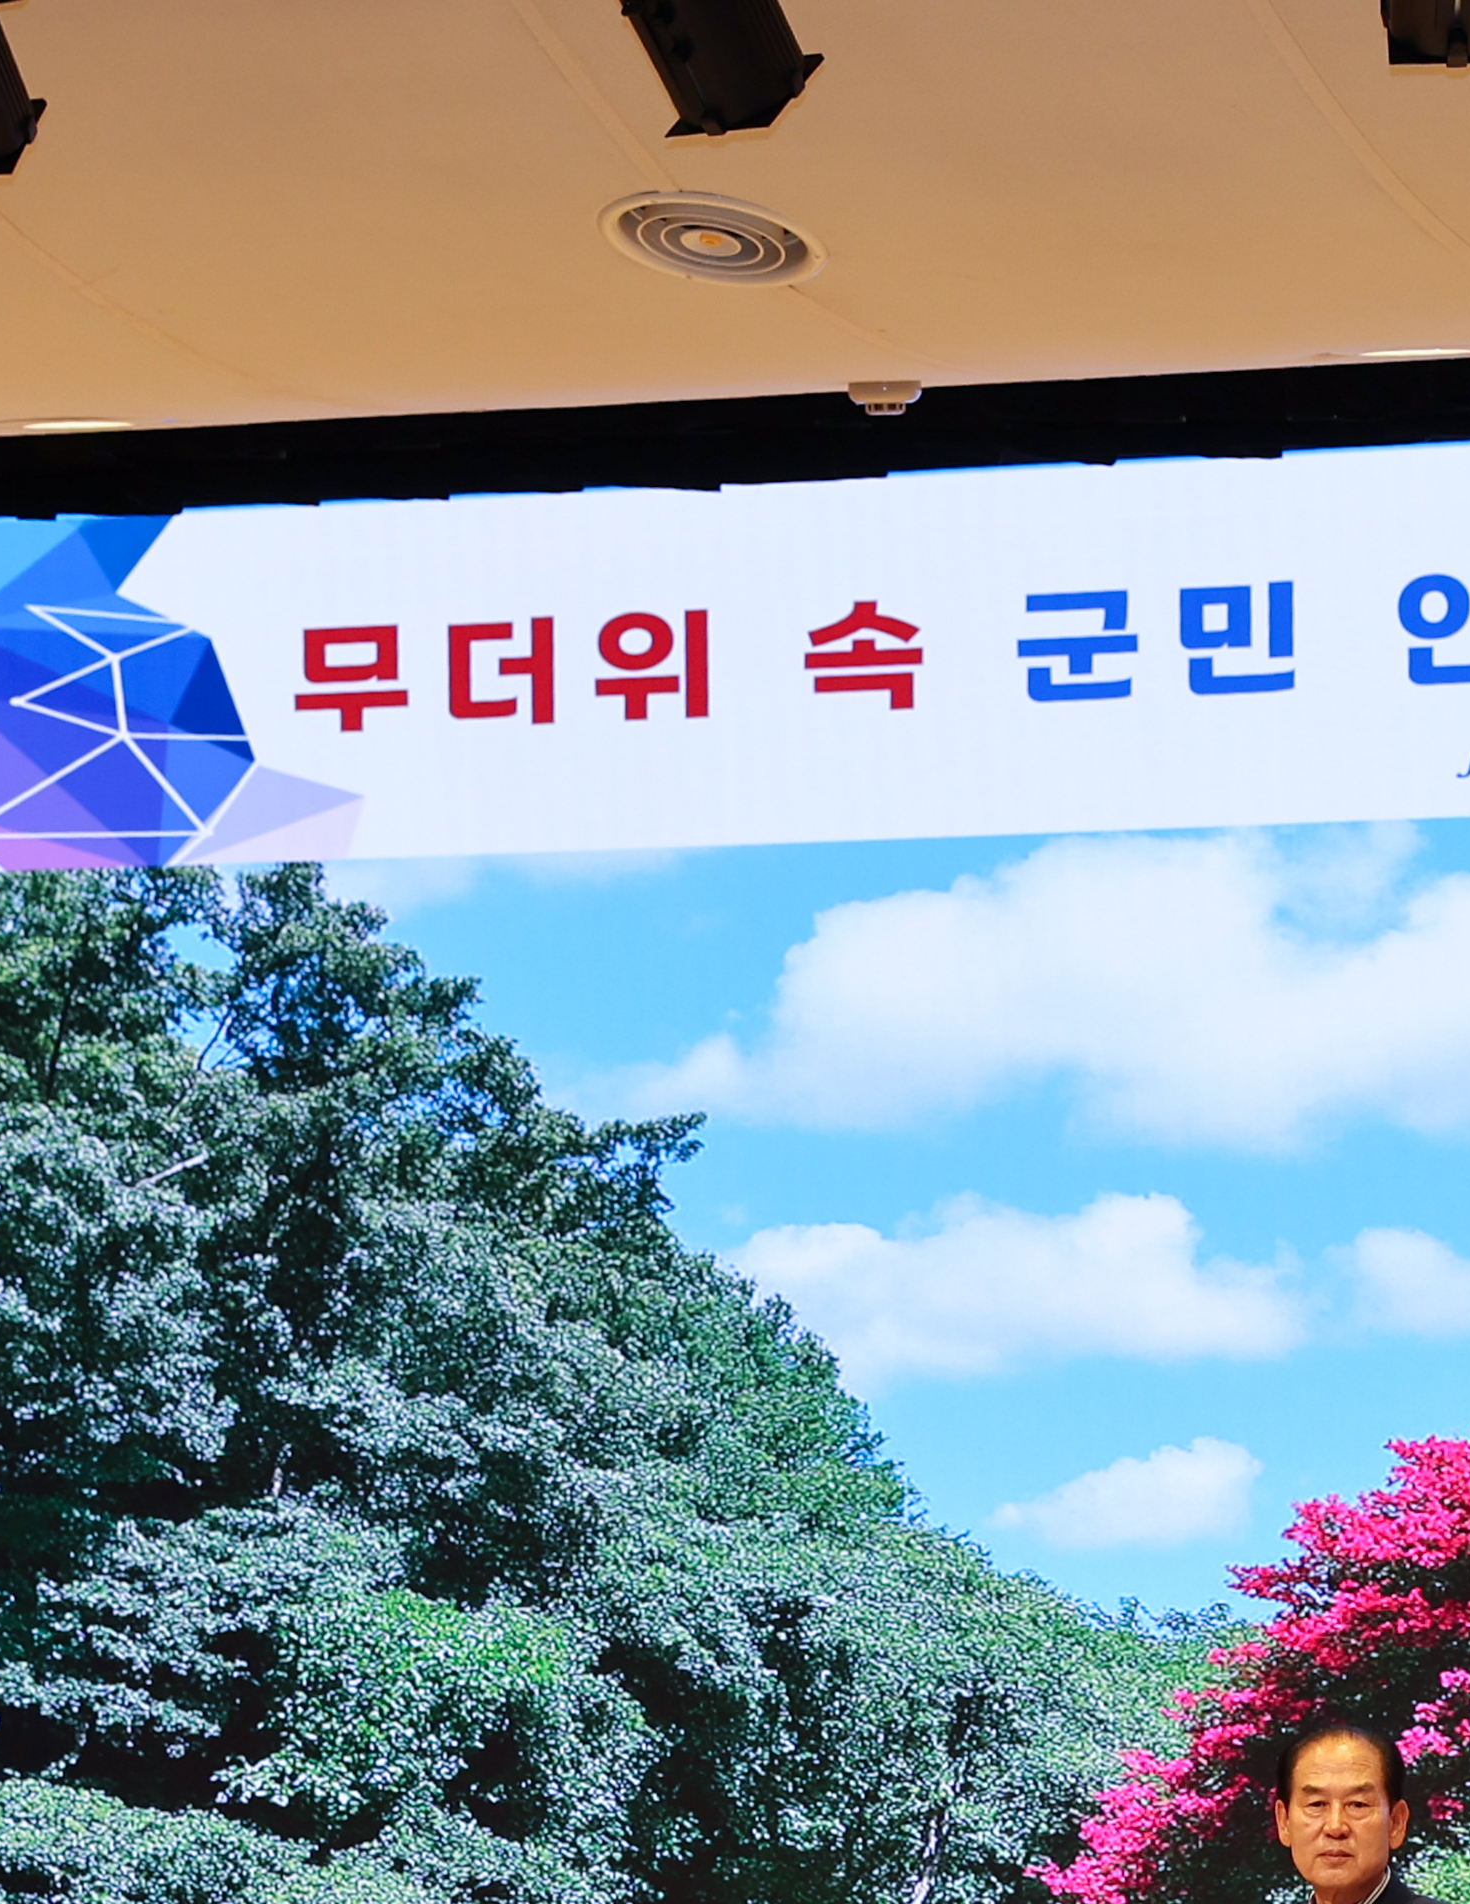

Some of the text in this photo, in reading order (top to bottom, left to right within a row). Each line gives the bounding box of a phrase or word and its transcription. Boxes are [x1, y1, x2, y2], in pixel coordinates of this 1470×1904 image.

[295, 610, 708, 731] 무더위
[805, 601, 923, 709] 속
[1017, 581, 1294, 702] 군민
